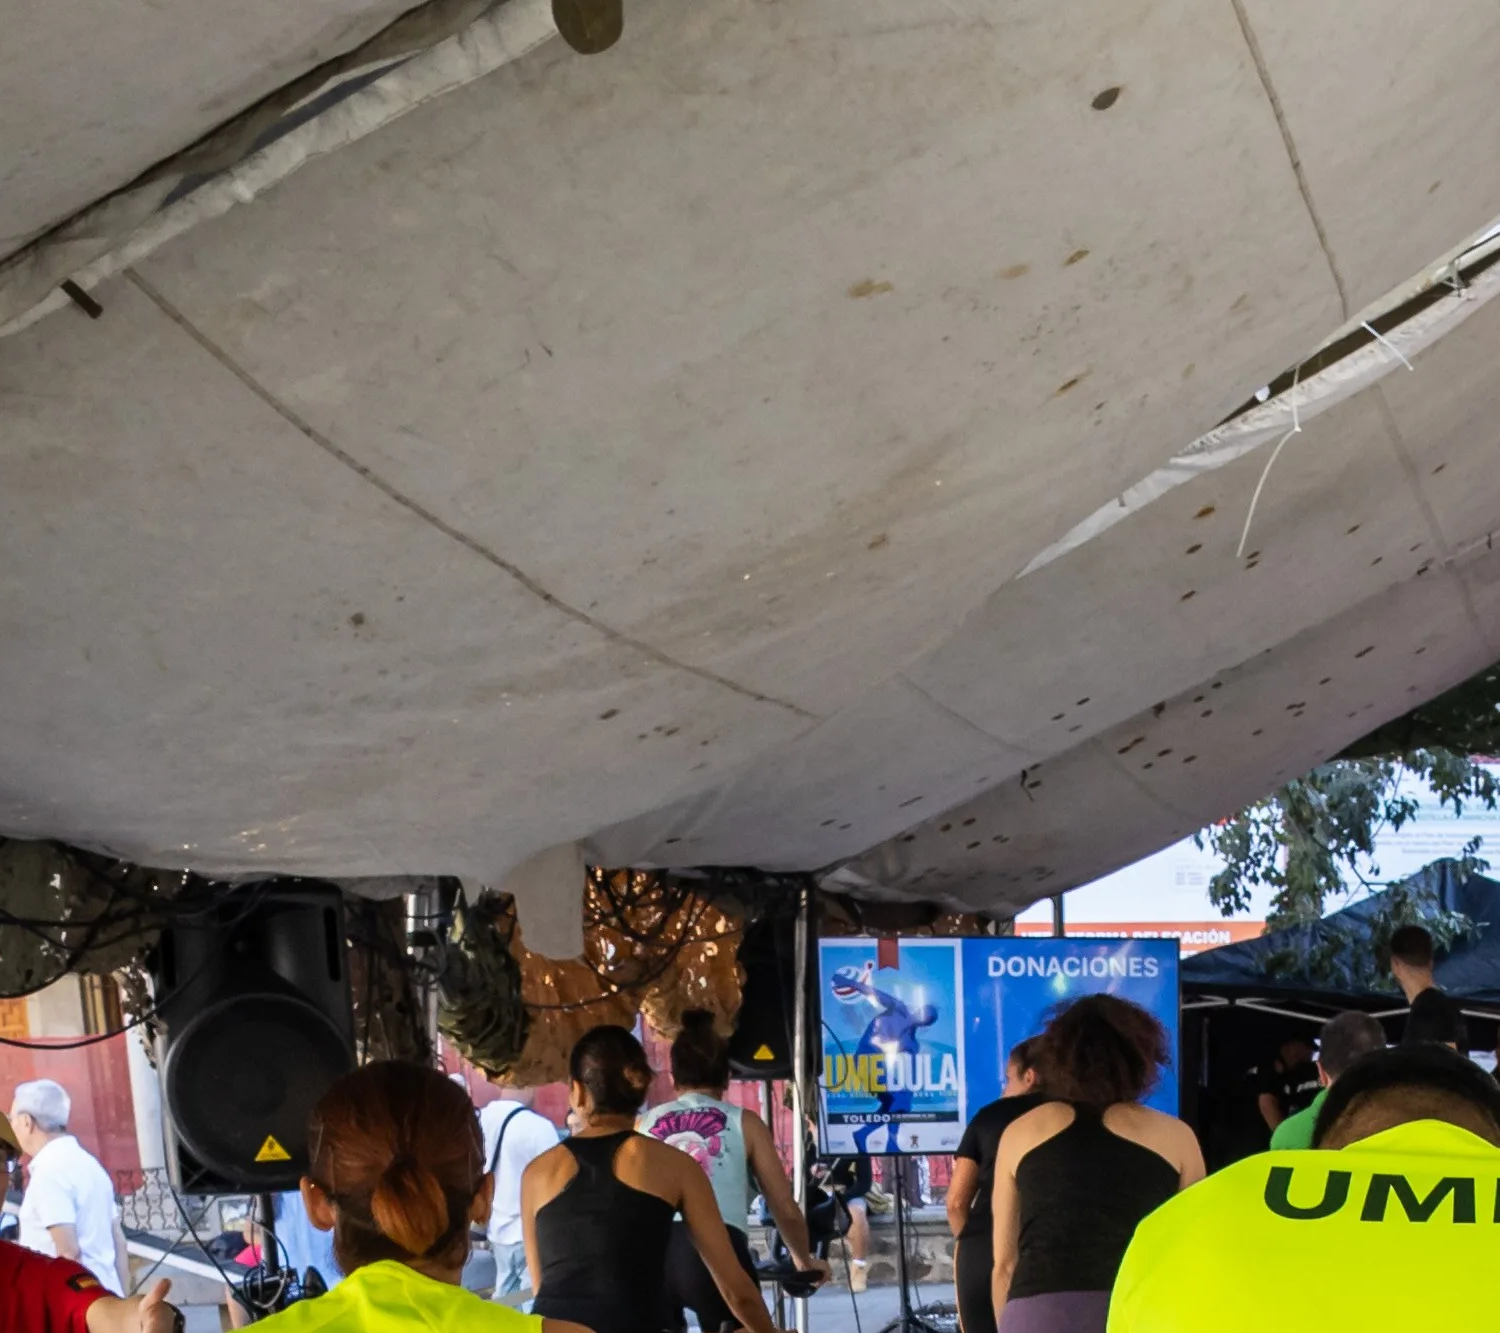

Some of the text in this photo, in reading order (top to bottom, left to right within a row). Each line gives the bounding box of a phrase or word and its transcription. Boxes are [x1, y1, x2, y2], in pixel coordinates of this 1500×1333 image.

[987, 955, 1160, 978] DONACIONES
[823, 1052, 959, 1094] UMEDULA
[842, 1113, 891, 1125] TOLEDO
